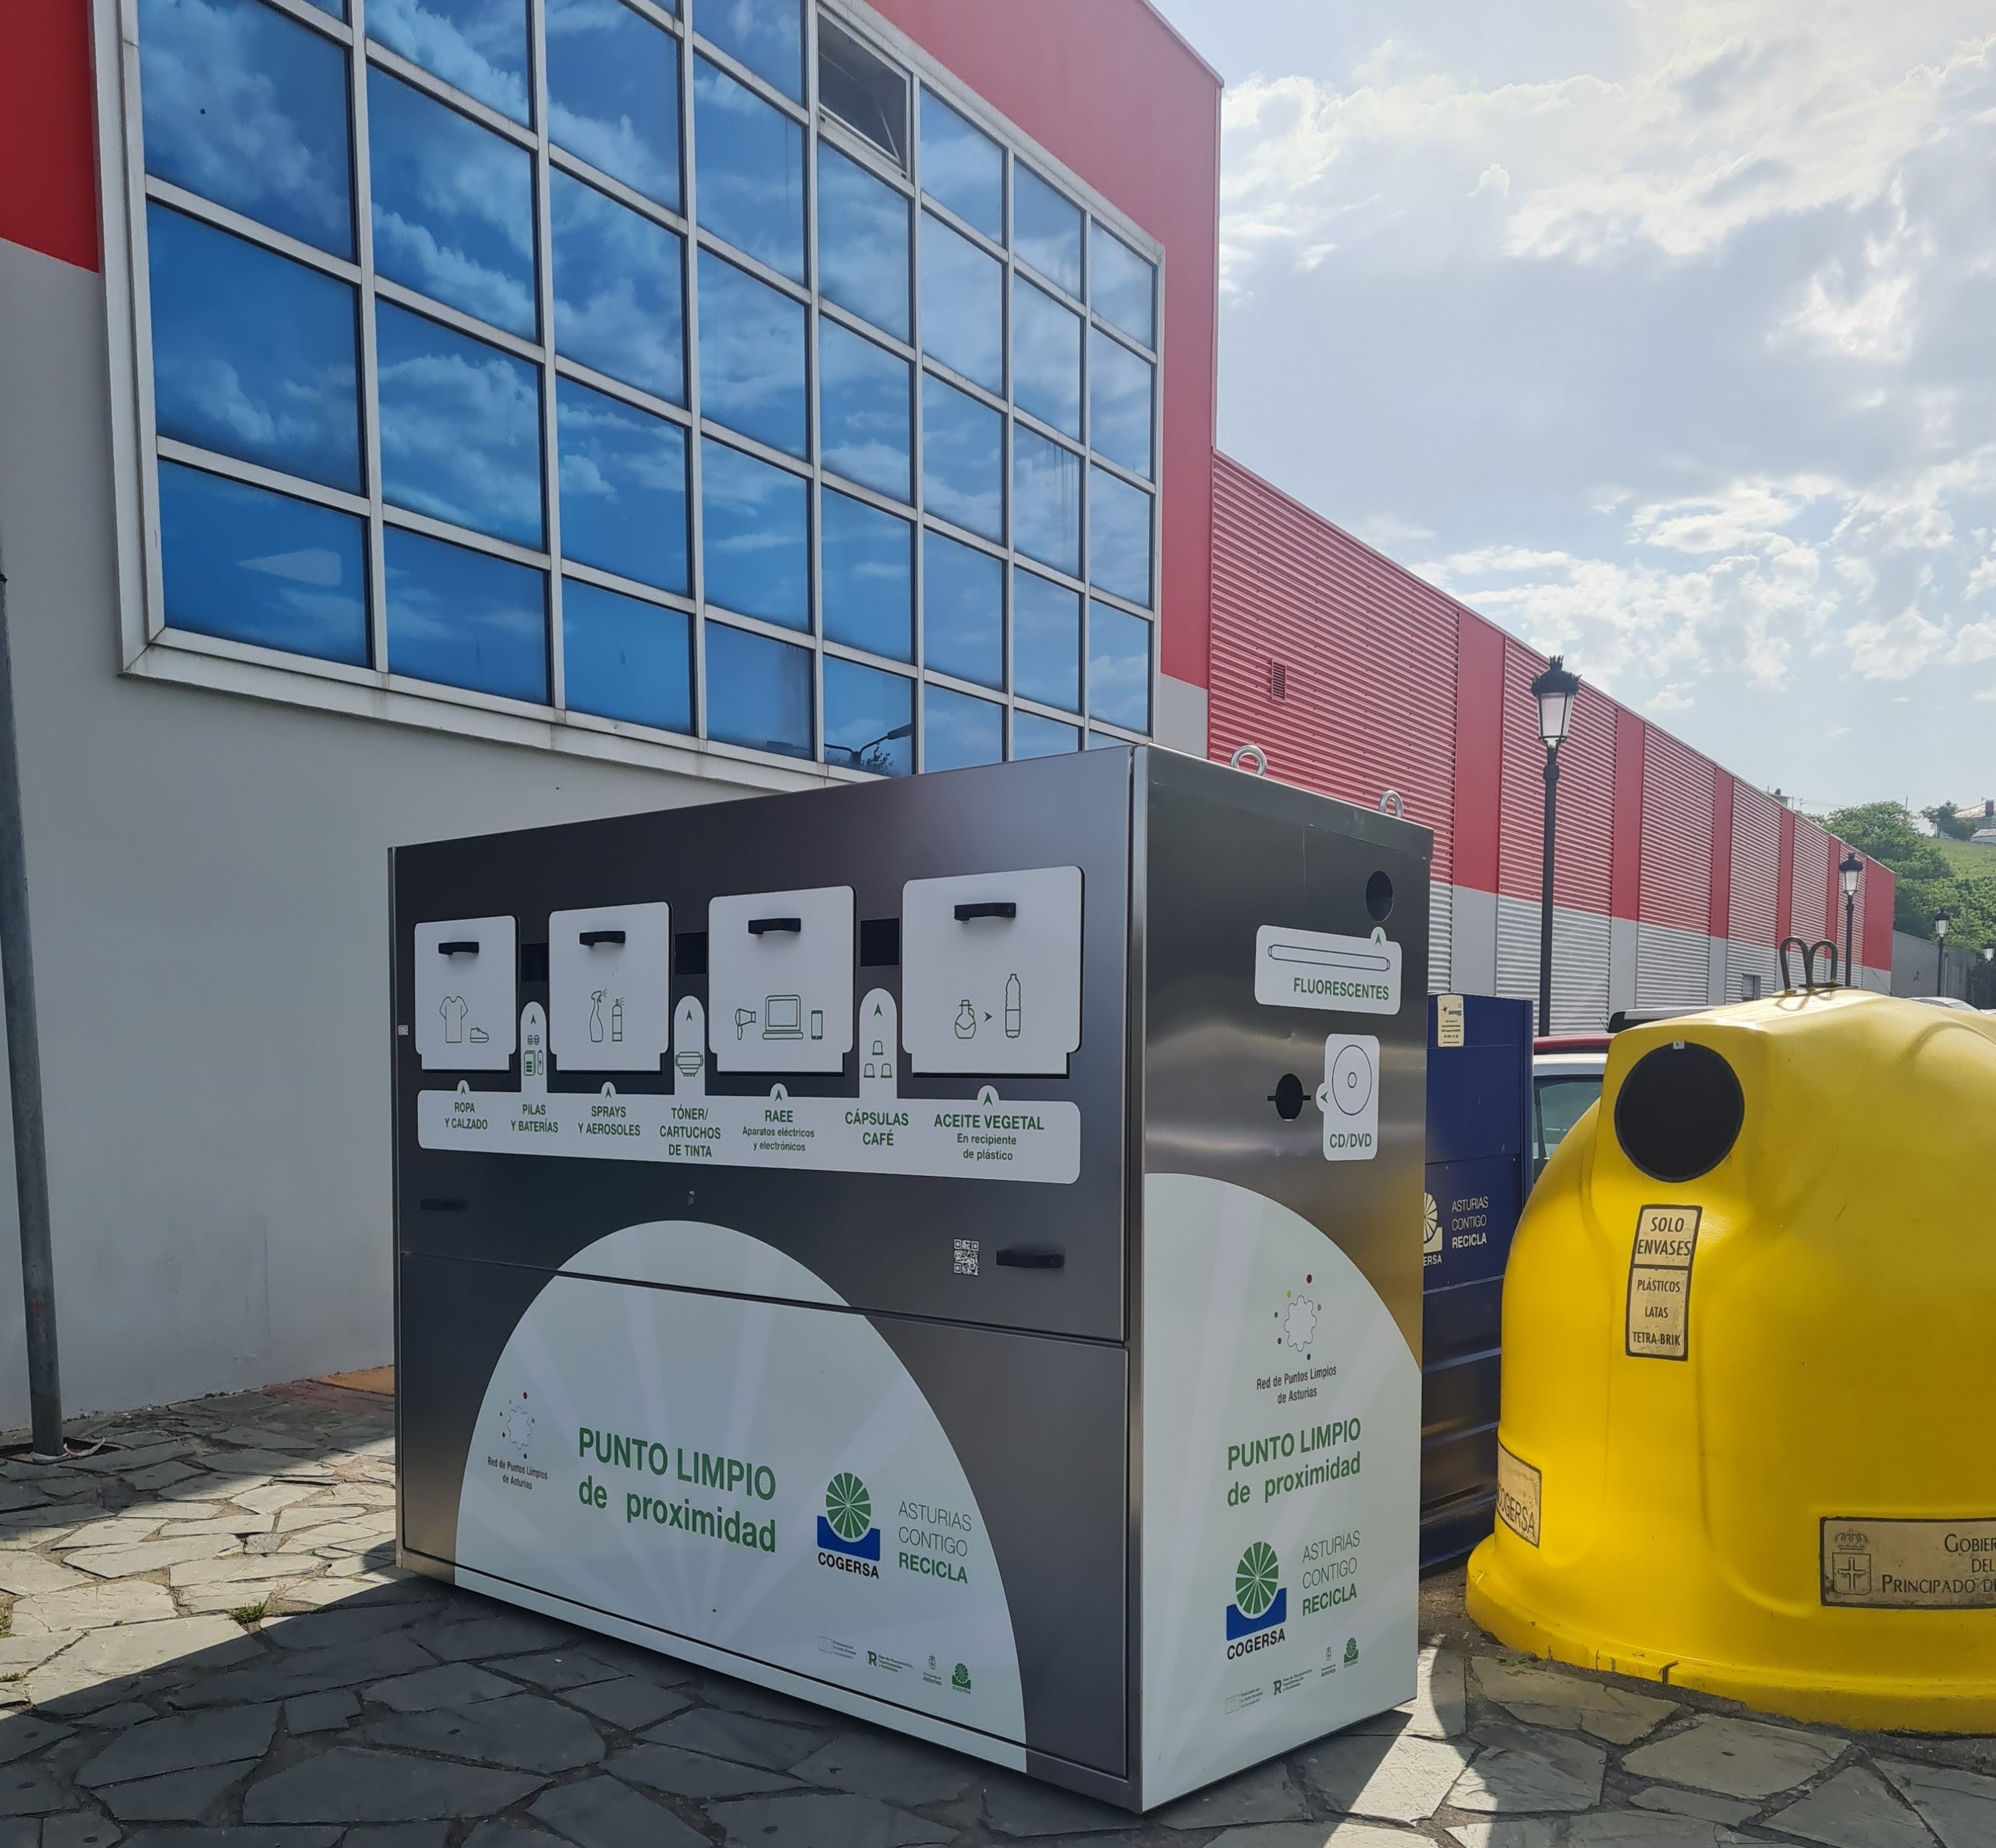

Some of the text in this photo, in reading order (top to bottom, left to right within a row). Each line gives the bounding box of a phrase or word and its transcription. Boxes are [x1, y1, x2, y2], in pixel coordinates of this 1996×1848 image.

[1293, 977, 1389, 1000] FLUORESCENTES
[454, 1102, 475, 1113] ROPA
[522, 1104, 546, 1115] PILAS
[591, 1105, 626, 1118] SPRAYS
[671, 1103, 709, 1121] TÓNER/
[764, 1109, 793, 1123] RAEE
[444, 1118, 488, 1130] Y CALZADO
[510, 1118, 559, 1133] Y BATERÍAS
[844, 1108, 909, 1126] CÁPSULAS
[933, 1114, 1045, 1130] ACEITE VEGETAL
[578, 1123, 641, 1137] Y AEROSOLES
[659, 1125, 721, 1139] CARTUCHOS
[742, 1125, 815, 1138] Aparatos eléctricos
[862, 1129, 894, 1146] CAFÉ
[753, 1140, 806, 1151] y electrónicos
[957, 1133, 1017, 1146] En recipiente
[1329, 1133, 1372, 1149] CD/DVD
[669, 1144, 713, 1158] DE TINTA
[963, 1149, 1013, 1161] de plástico
[1452, 1196, 1488, 1213] ASTURIAS
[1452, 1214, 1487, 1231] CONTIGO
[1650, 1216, 1685, 1232] SOLO
[1452, 1232, 1487, 1249] RECICLA
[1637, 1239, 1692, 1256] ENVASES
[1637, 1277, 1681, 1293] PLÁSTICOS
[1645, 1306, 1669, 1318] LATAS
[1632, 1331, 1681, 1346] TETRA-BRIK
[1256, 1366, 1337, 1391] Red de Puntos Limpios
[1277, 1386, 1317, 1404] de Asturias
[1228, 1417, 1361, 1471] PUNTO LIMPIO
[487, 1456, 548, 1480] Red de Puntos Limpios
[579, 1427, 776, 1501] PUNTO LIMPIO
[502, 1474, 532, 1490] de Asturias
[1227, 1451, 1361, 1507] de proximidad
[578, 1475, 776, 1553] de proximidad
[899, 1501, 972, 1531] ASTURIAS
[898, 1527, 968, 1557] CONTIGO
[1302, 1530, 1361, 1563] ASTURIAS
[818, 1552, 880, 1580] COGERSA
[898, 1551, 968, 1584] RECICLA
[1302, 1557, 1357, 1589] CONTIGO
[1972, 1559, 1995, 1572] DEL
[1882, 1574, 1996, 1594] PRINCIPADO D
[1302, 1582, 1357, 1616] RECICLA
[1227, 1628, 1285, 1660] COGERSA
